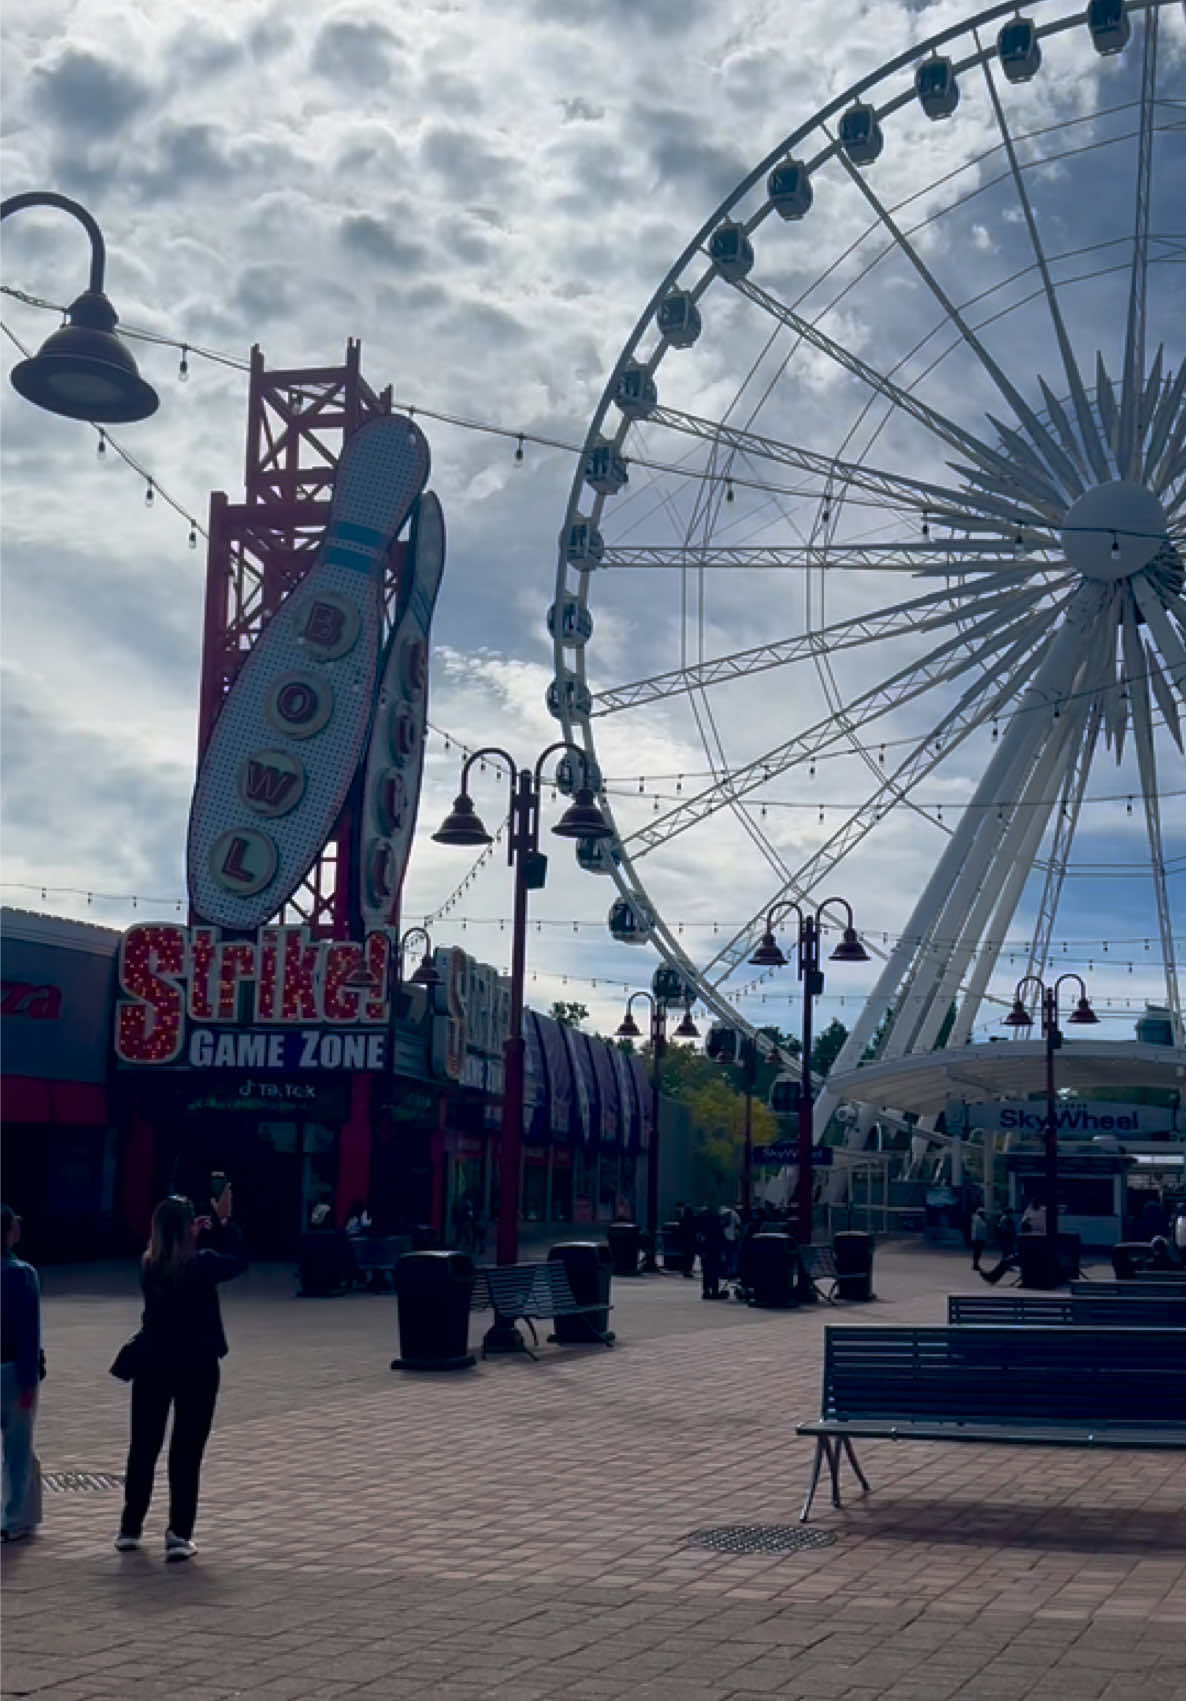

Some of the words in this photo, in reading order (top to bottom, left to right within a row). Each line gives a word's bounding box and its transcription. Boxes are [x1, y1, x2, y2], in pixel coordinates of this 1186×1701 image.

[219, 599, 345, 884] BOWL
[115, 921, 391, 1064] Strike!
[189, 1030, 285, 1068] GAME
[298, 1030, 384, 1069] ZONE
[1000, 1109, 1139, 1131] SkyWheel
